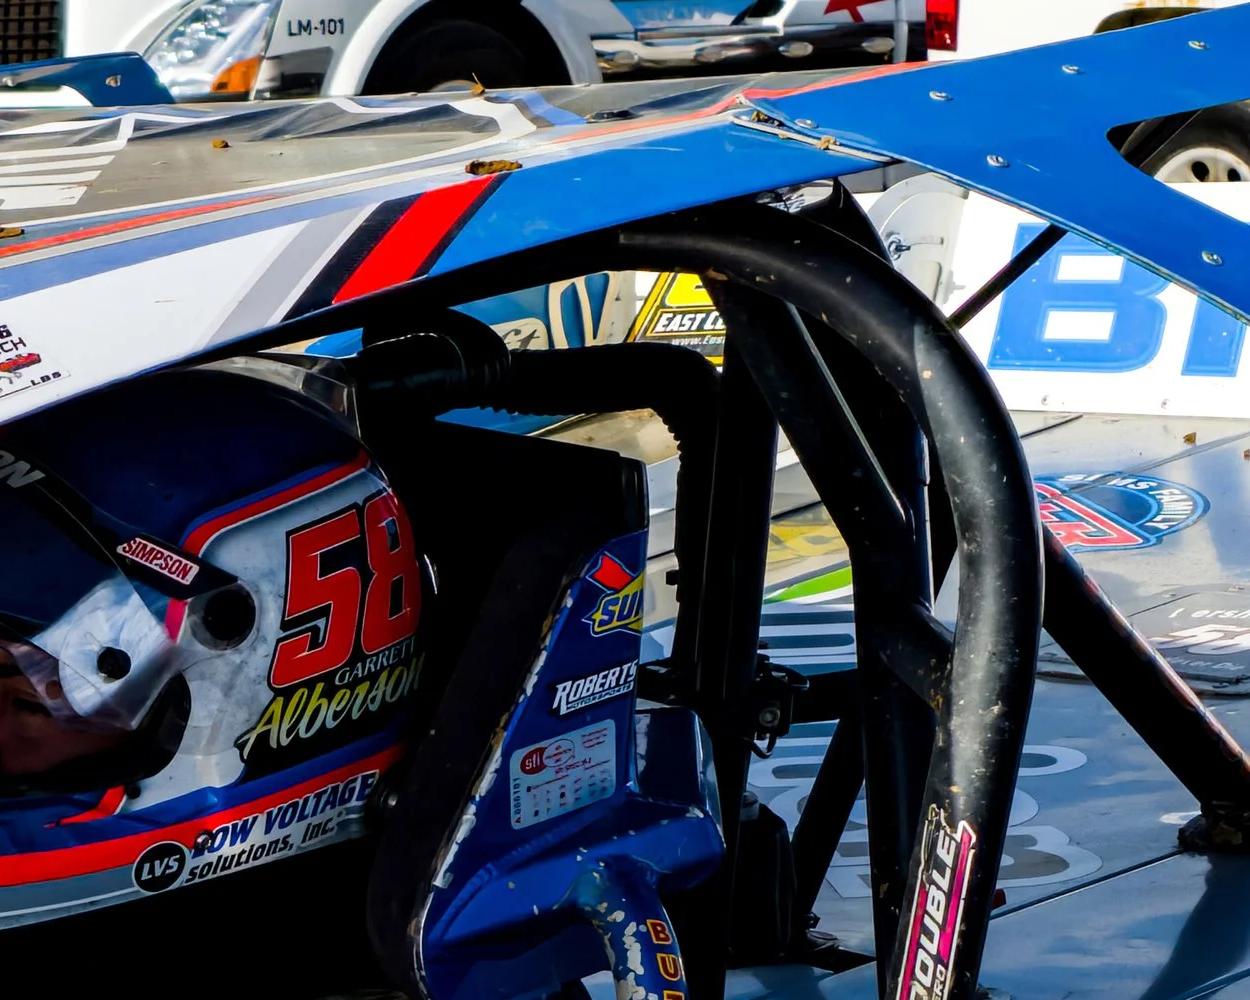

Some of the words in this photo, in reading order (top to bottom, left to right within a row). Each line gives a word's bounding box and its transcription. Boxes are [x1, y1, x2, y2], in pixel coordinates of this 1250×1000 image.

[287, 18, 345, 36] LM-101
[652, 312, 706, 333] EAST
[30, 371, 62, 387] LBS
[1145, 488, 1195, 530] FAMILY
[122, 540, 193, 583] SIMPSON
[271, 490, 421, 689] 58
[236, 652, 426, 760] Alberson
[552, 657, 639, 716] ROBERTS
[263, 771, 379, 836] VOLTAGE
[141, 855, 180, 881] LVS
[185, 833, 295, 885] solutions,
